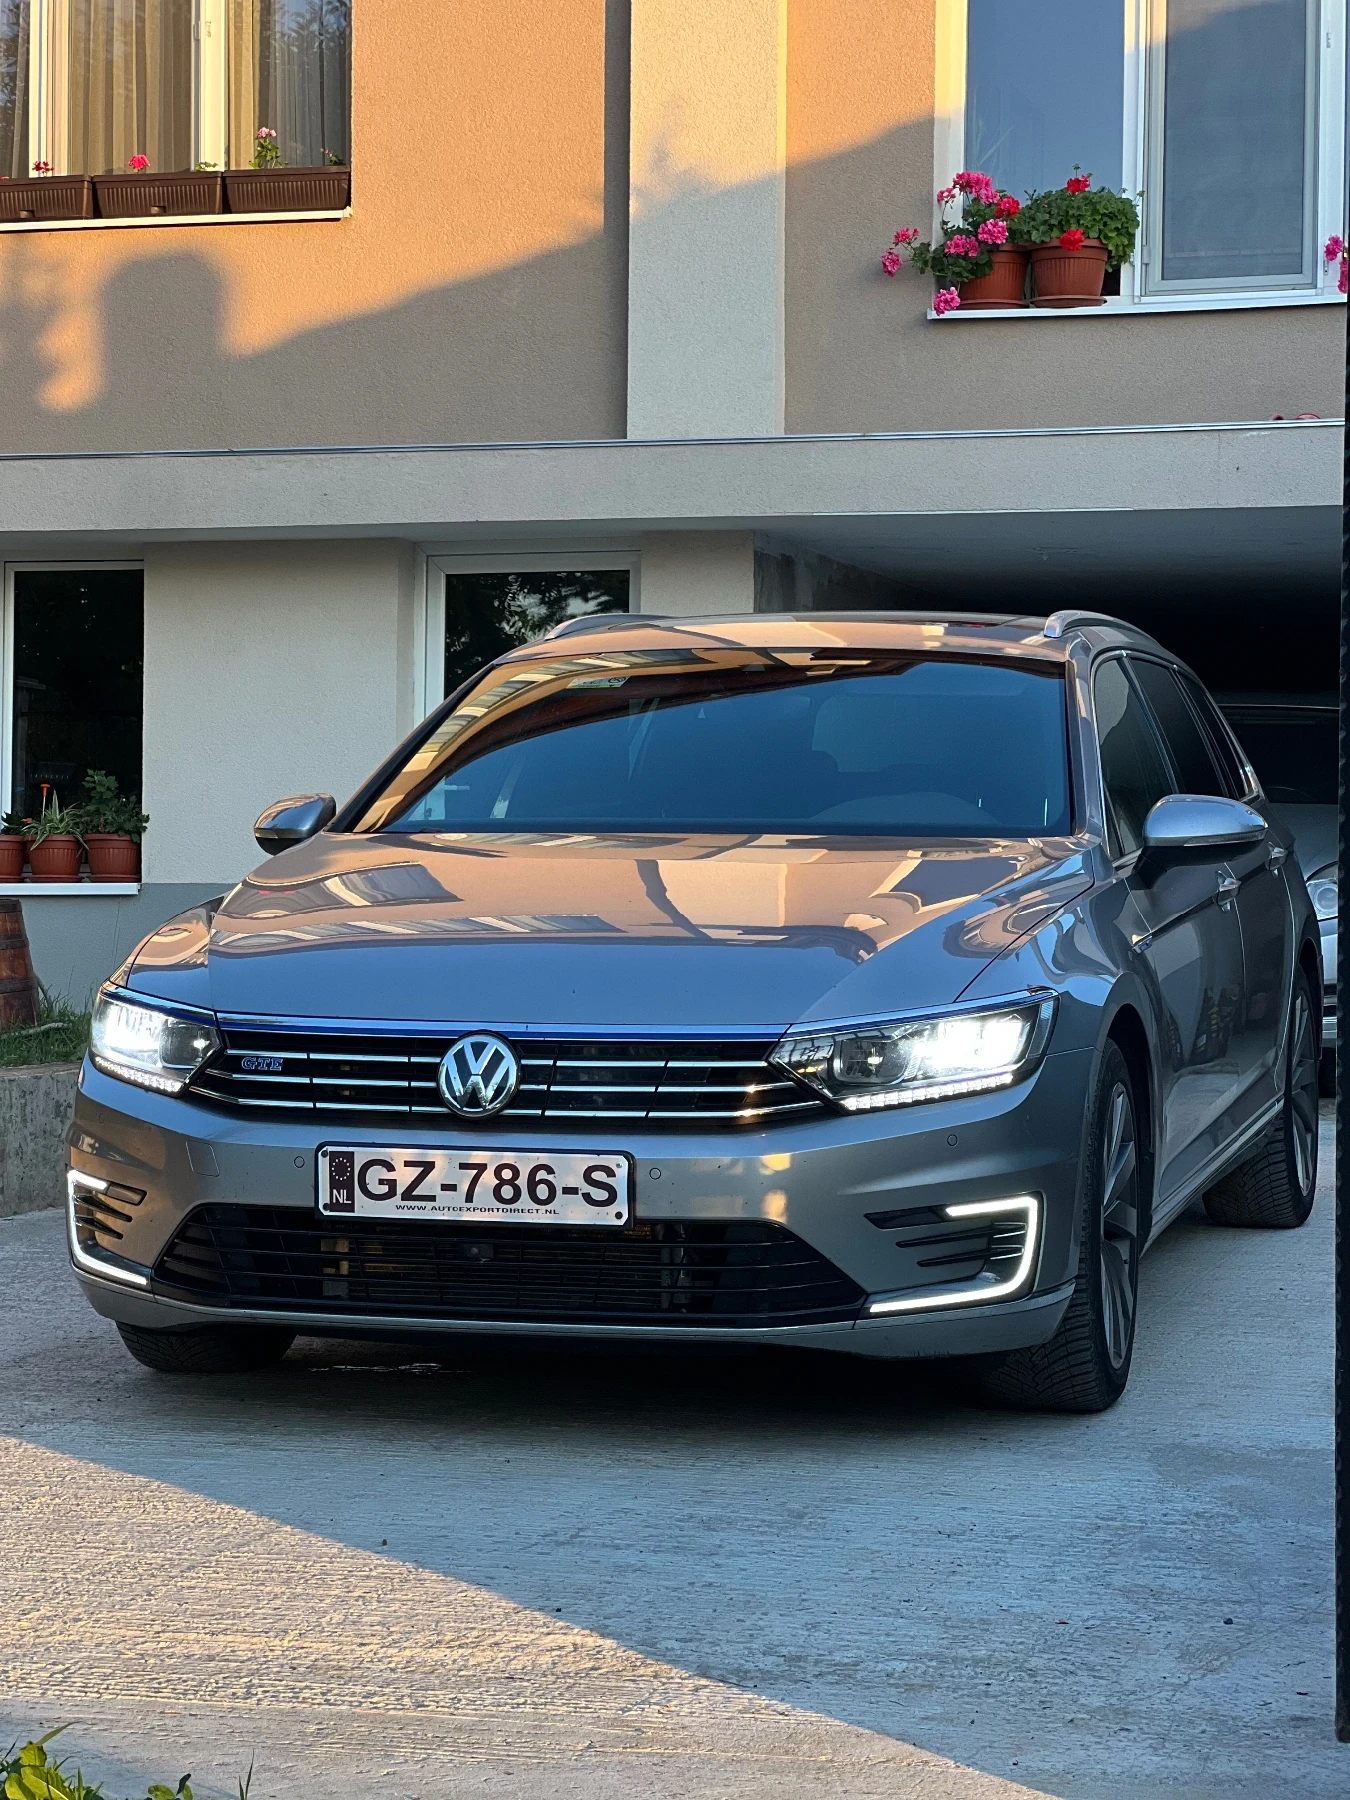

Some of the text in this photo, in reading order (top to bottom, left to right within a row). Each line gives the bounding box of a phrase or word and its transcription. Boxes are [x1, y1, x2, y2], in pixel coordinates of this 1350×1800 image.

[241, 1057, 284, 1071] GTE
[357, 1158, 618, 1207] GZ-786-S
[332, 1189, 352, 1204] NL
[395, 1204, 560, 1215] WWW.AUTOEXPORTDIRECT.NL
